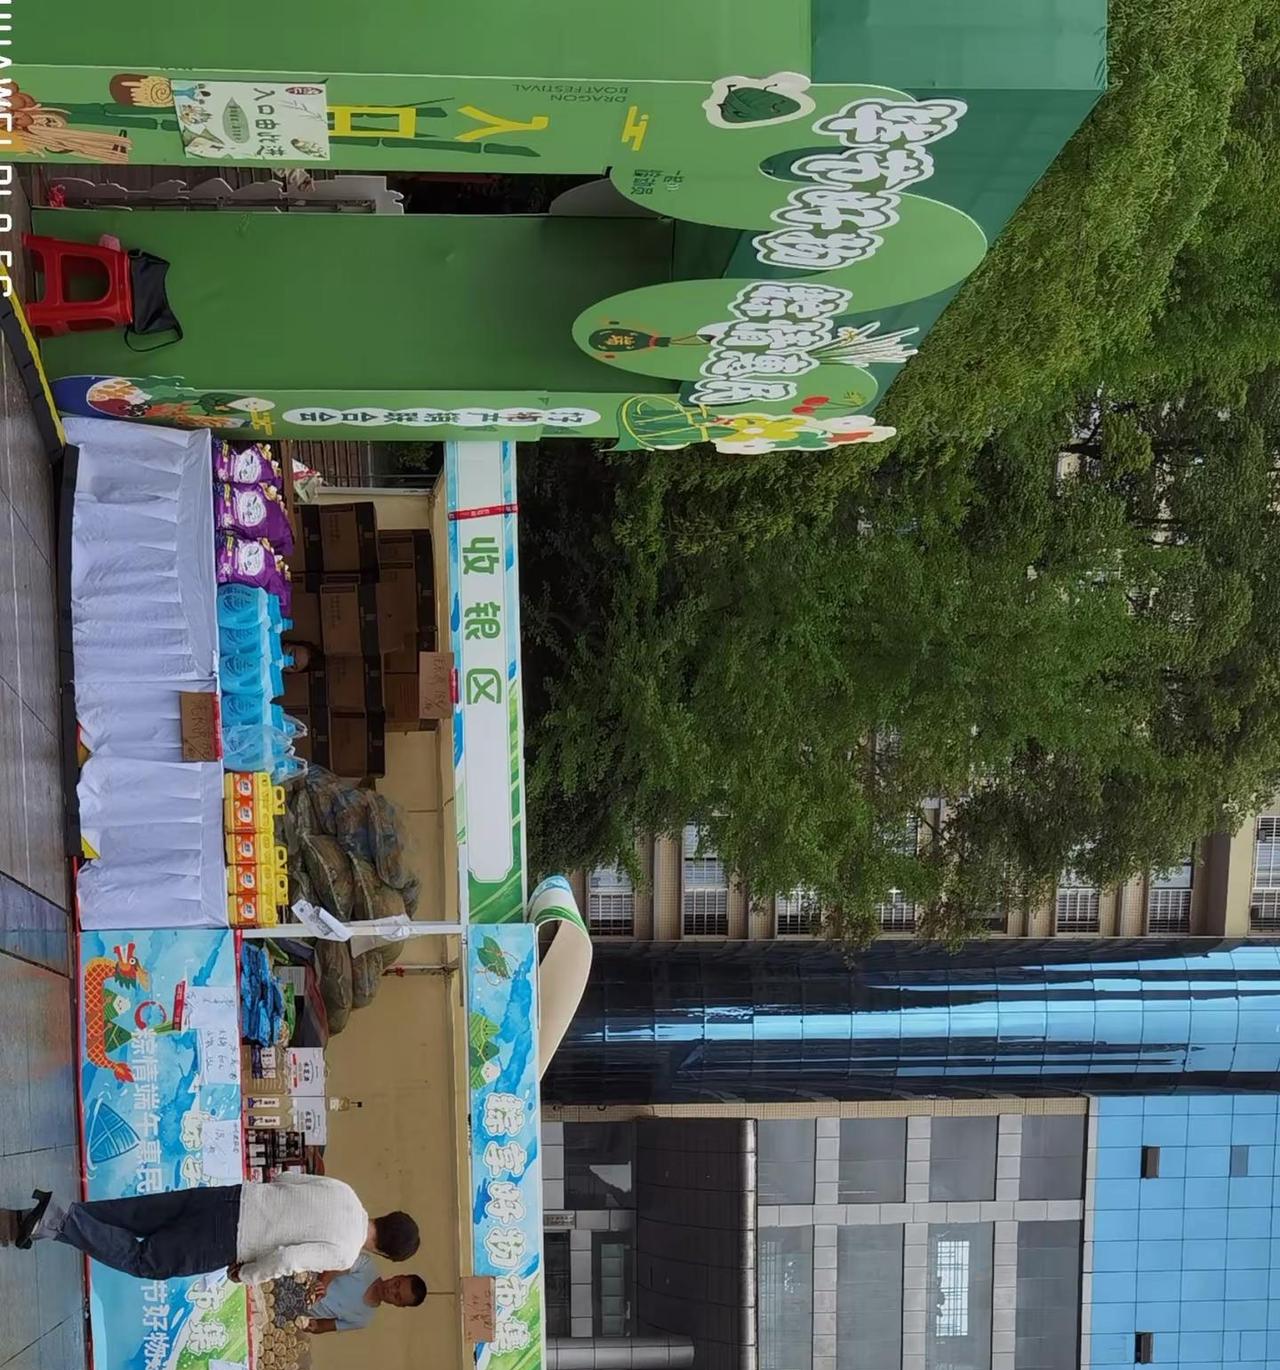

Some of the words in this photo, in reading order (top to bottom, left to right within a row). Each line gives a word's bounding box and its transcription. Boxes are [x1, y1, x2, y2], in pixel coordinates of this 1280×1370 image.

[253, 88, 286, 156] 入口由此进
[758, 100, 964, 268] 毕节好物
[691, 283, 849, 404] 粽情惠民
[462, 537, 502, 705] 收银区
[485, 1093, 529, 1353] 粽享好物市集
